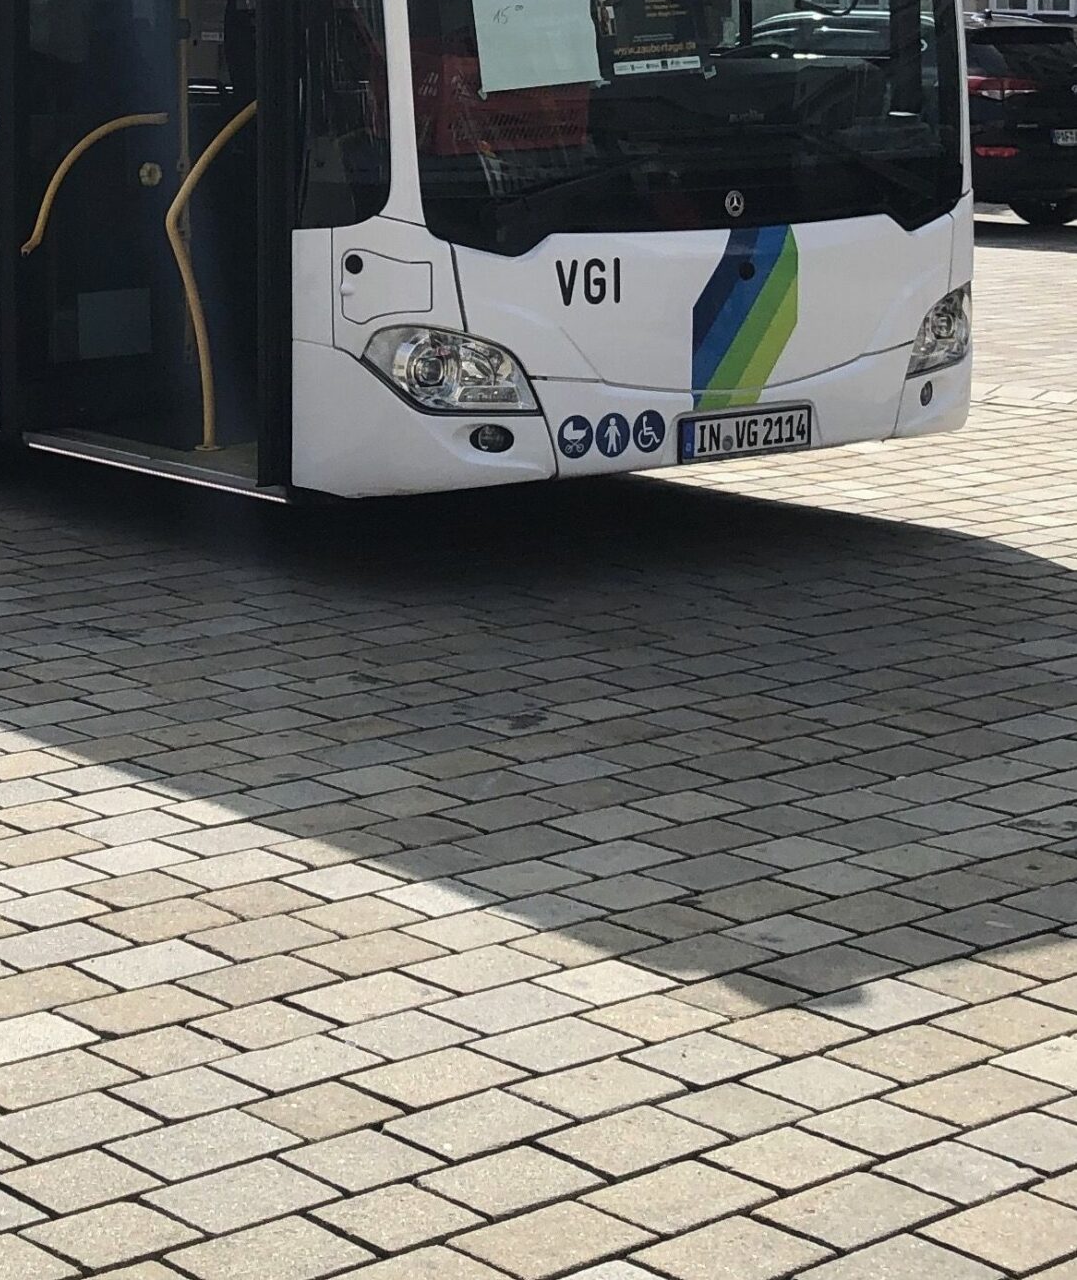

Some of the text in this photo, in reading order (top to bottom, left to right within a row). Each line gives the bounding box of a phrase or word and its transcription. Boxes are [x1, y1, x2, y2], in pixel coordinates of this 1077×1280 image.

[555, 256, 621, 307] VGI
[697, 413, 806, 453] IN VG 2114
